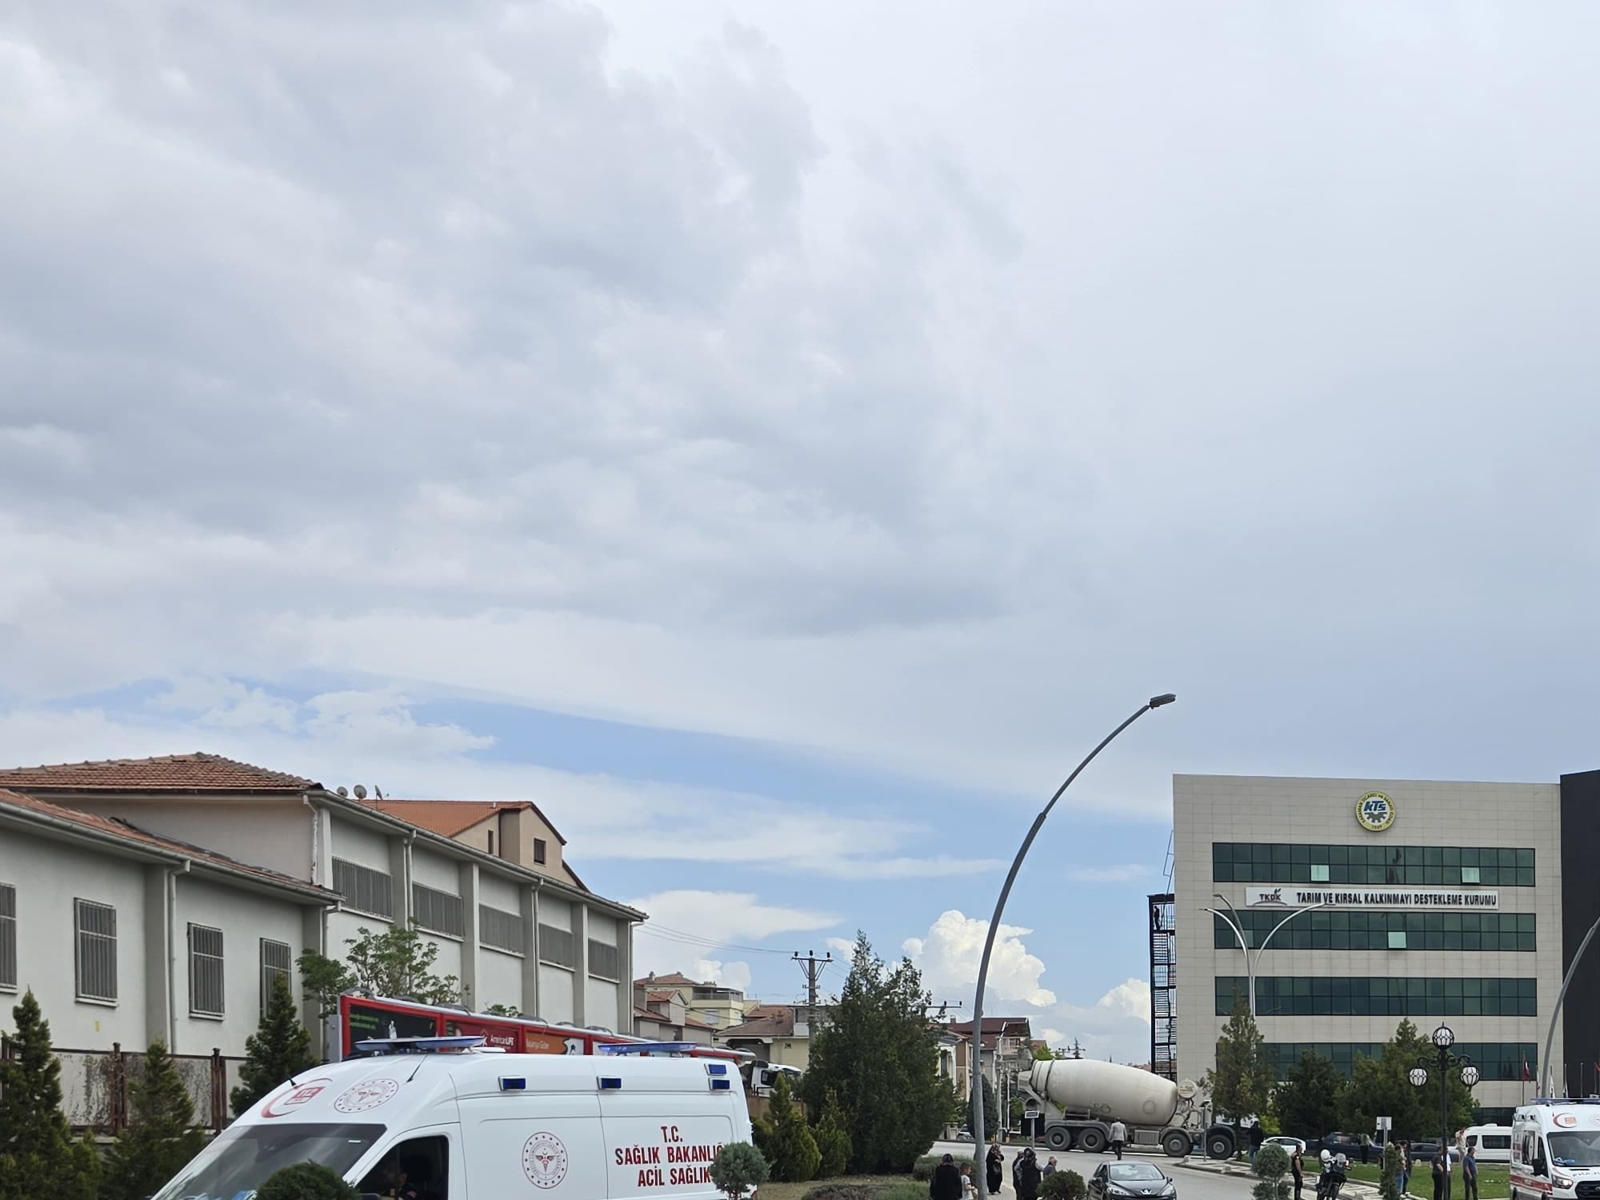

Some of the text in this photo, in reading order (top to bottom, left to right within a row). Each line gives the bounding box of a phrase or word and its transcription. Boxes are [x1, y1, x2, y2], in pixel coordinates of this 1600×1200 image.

[1297, 892, 1497, 905] TARIM VE KIRSAL KALKINMAYI DESTEKLEME KURUMU
[661, 1126, 683, 1143] T.C.
[615, 1143, 724, 1165] SAĞLIK BAKANLIĞ
[638, 1165, 711, 1187] ACİL SAĞLIK
